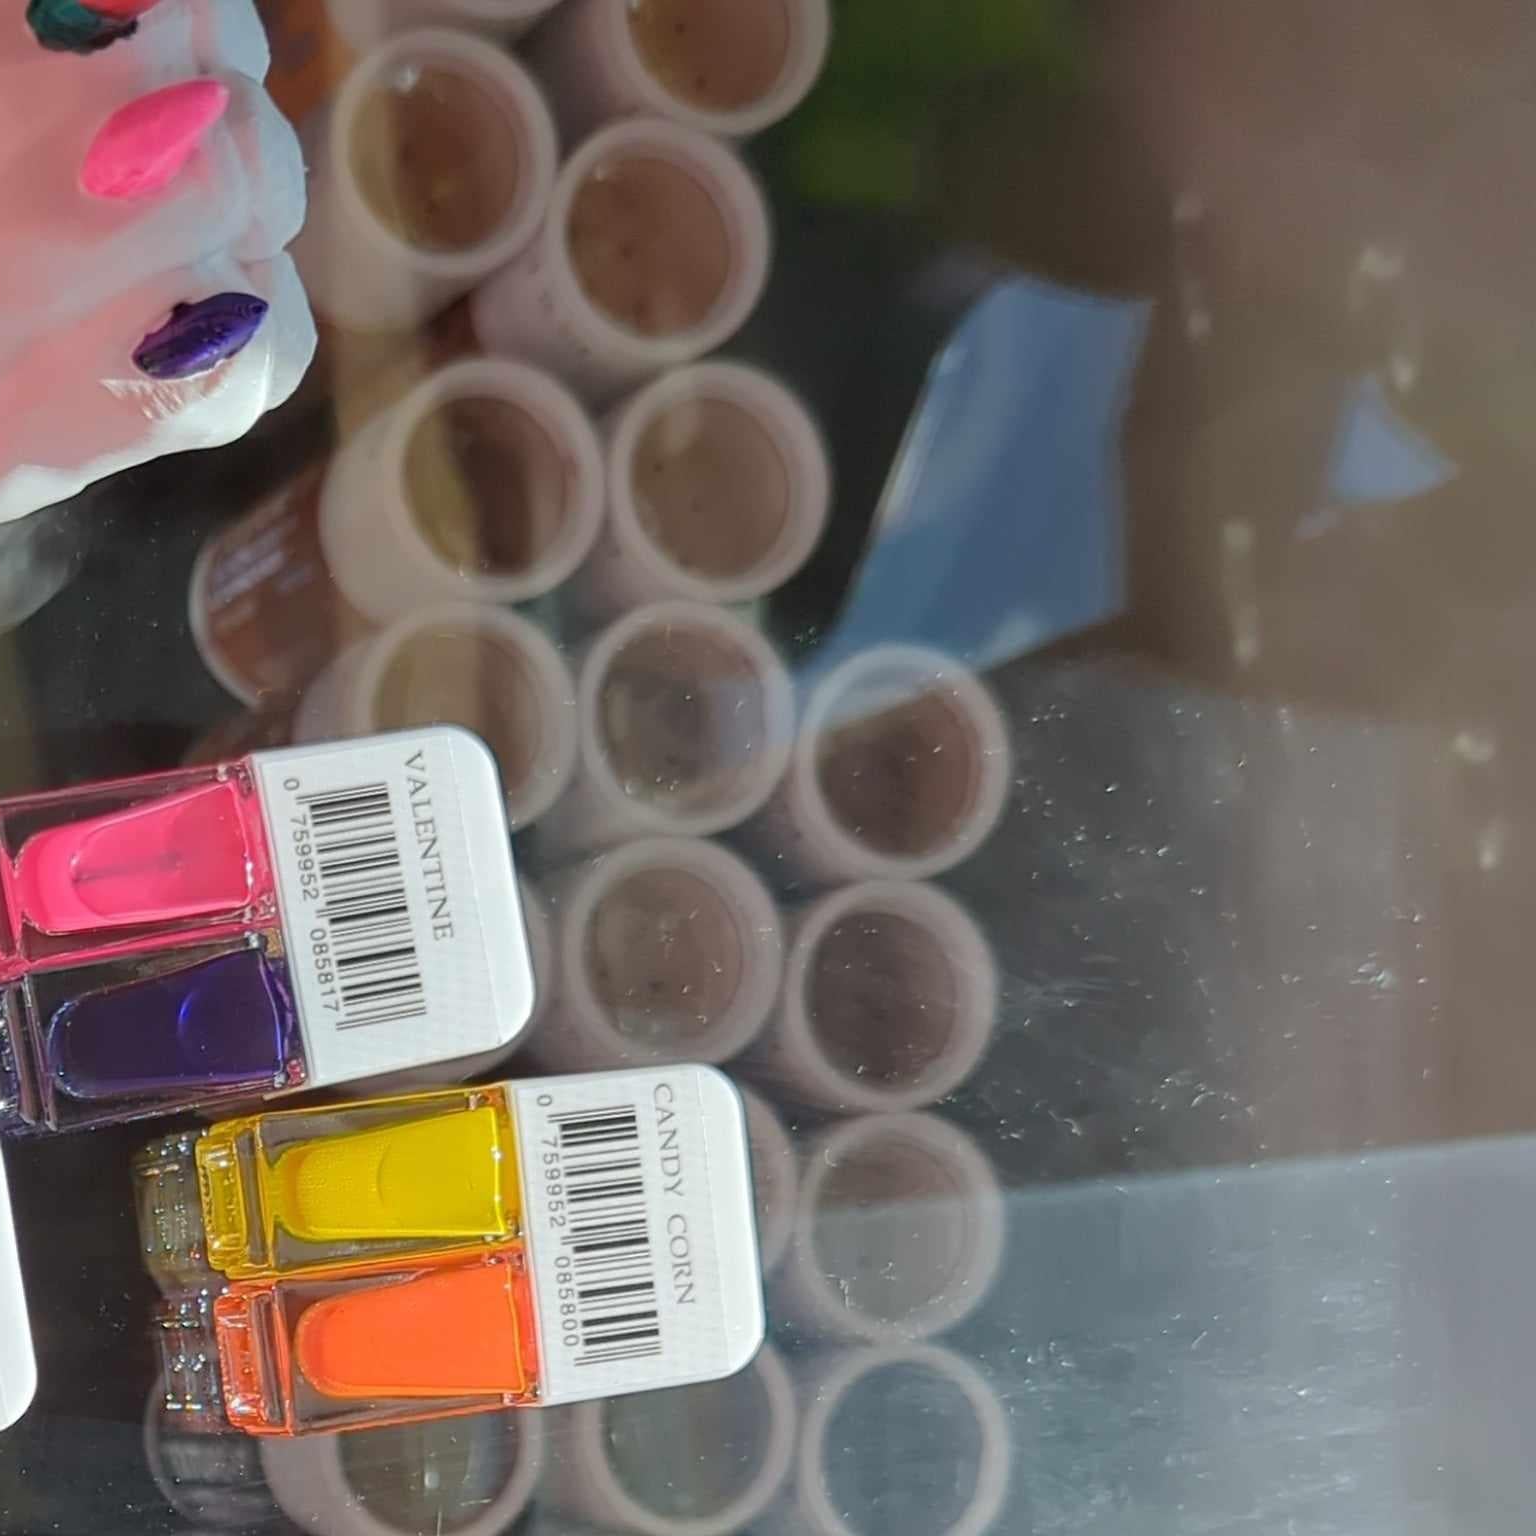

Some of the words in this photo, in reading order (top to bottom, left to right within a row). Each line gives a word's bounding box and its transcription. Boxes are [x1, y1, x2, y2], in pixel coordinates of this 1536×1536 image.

[283, 777, 301, 792] 0
[290, 814, 320, 901] 759952
[403, 749, 454, 941] VALENTINE
[310, 928, 340, 1013] 085817
[536, 1093, 553, 1107] 0
[653, 1082, 684, 1197] CANDY
[541, 1135, 567, 1229] 759952
[554, 1256, 580, 1347] 085800
[666, 1214, 696, 1305] CORN
